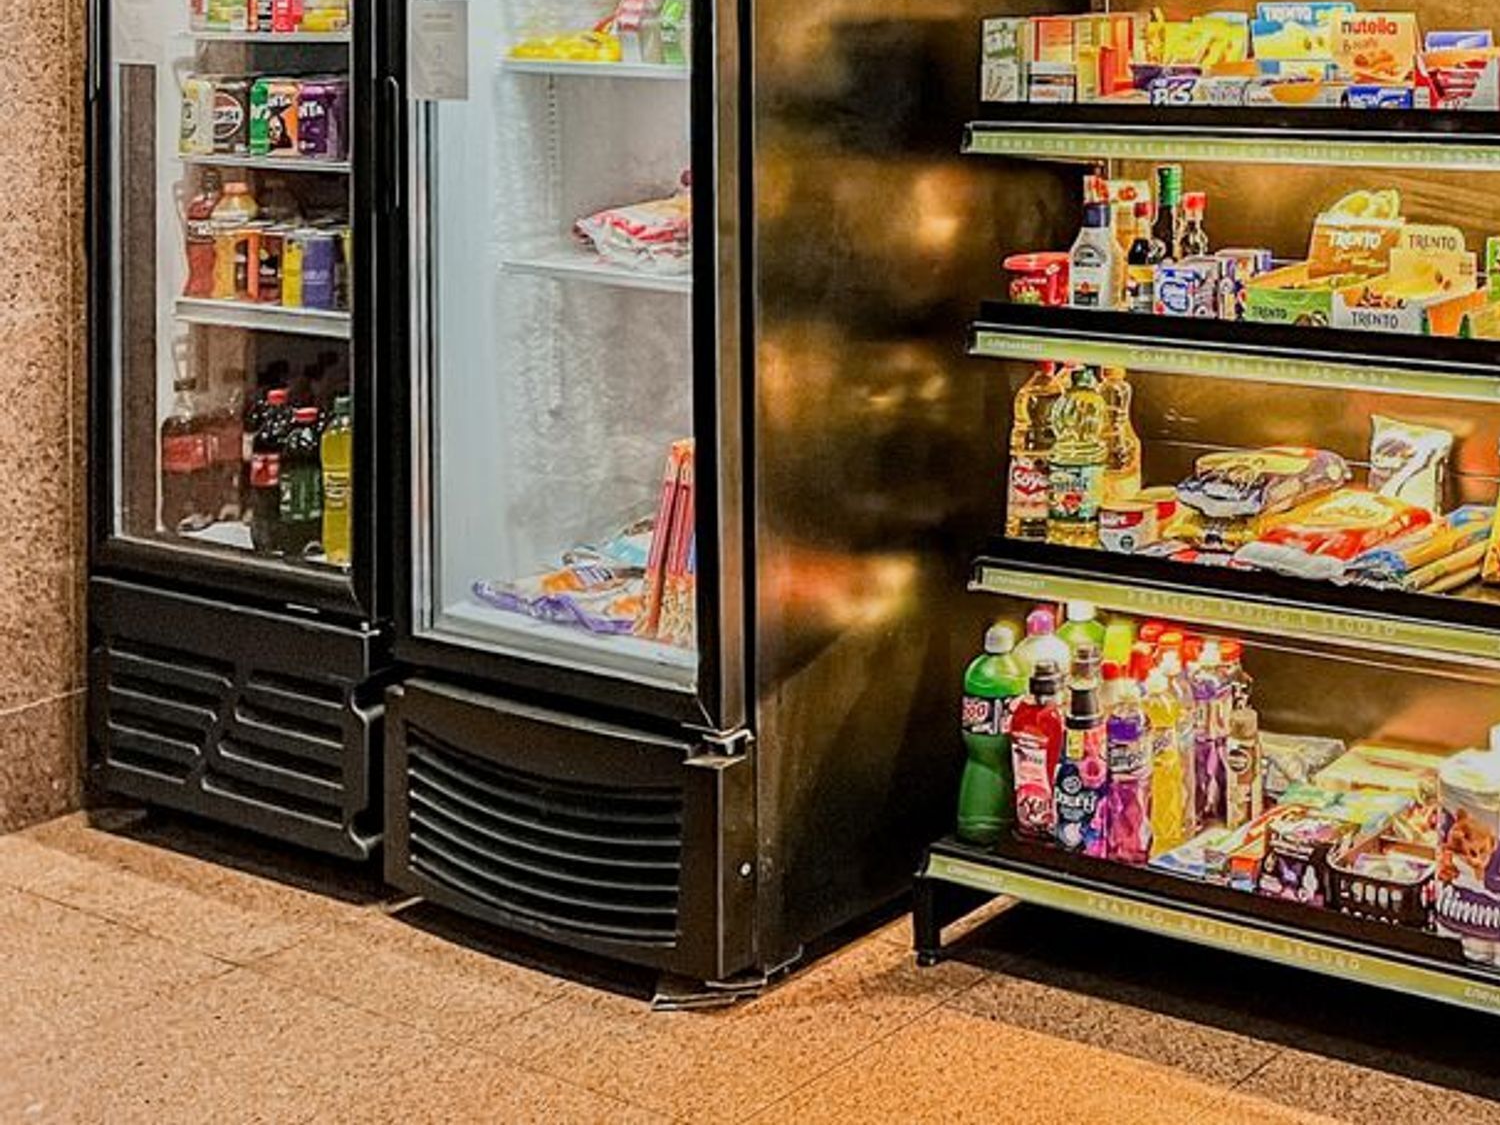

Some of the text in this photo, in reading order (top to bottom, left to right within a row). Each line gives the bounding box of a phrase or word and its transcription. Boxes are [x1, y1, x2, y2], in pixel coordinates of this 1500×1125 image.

[1341, 16, 1399, 36] nutella
[1408, 233, 1458, 251] TRENTO
[1251, 305, 1288, 320] TRENTO
[1350, 311, 1399, 329] TRENTO
